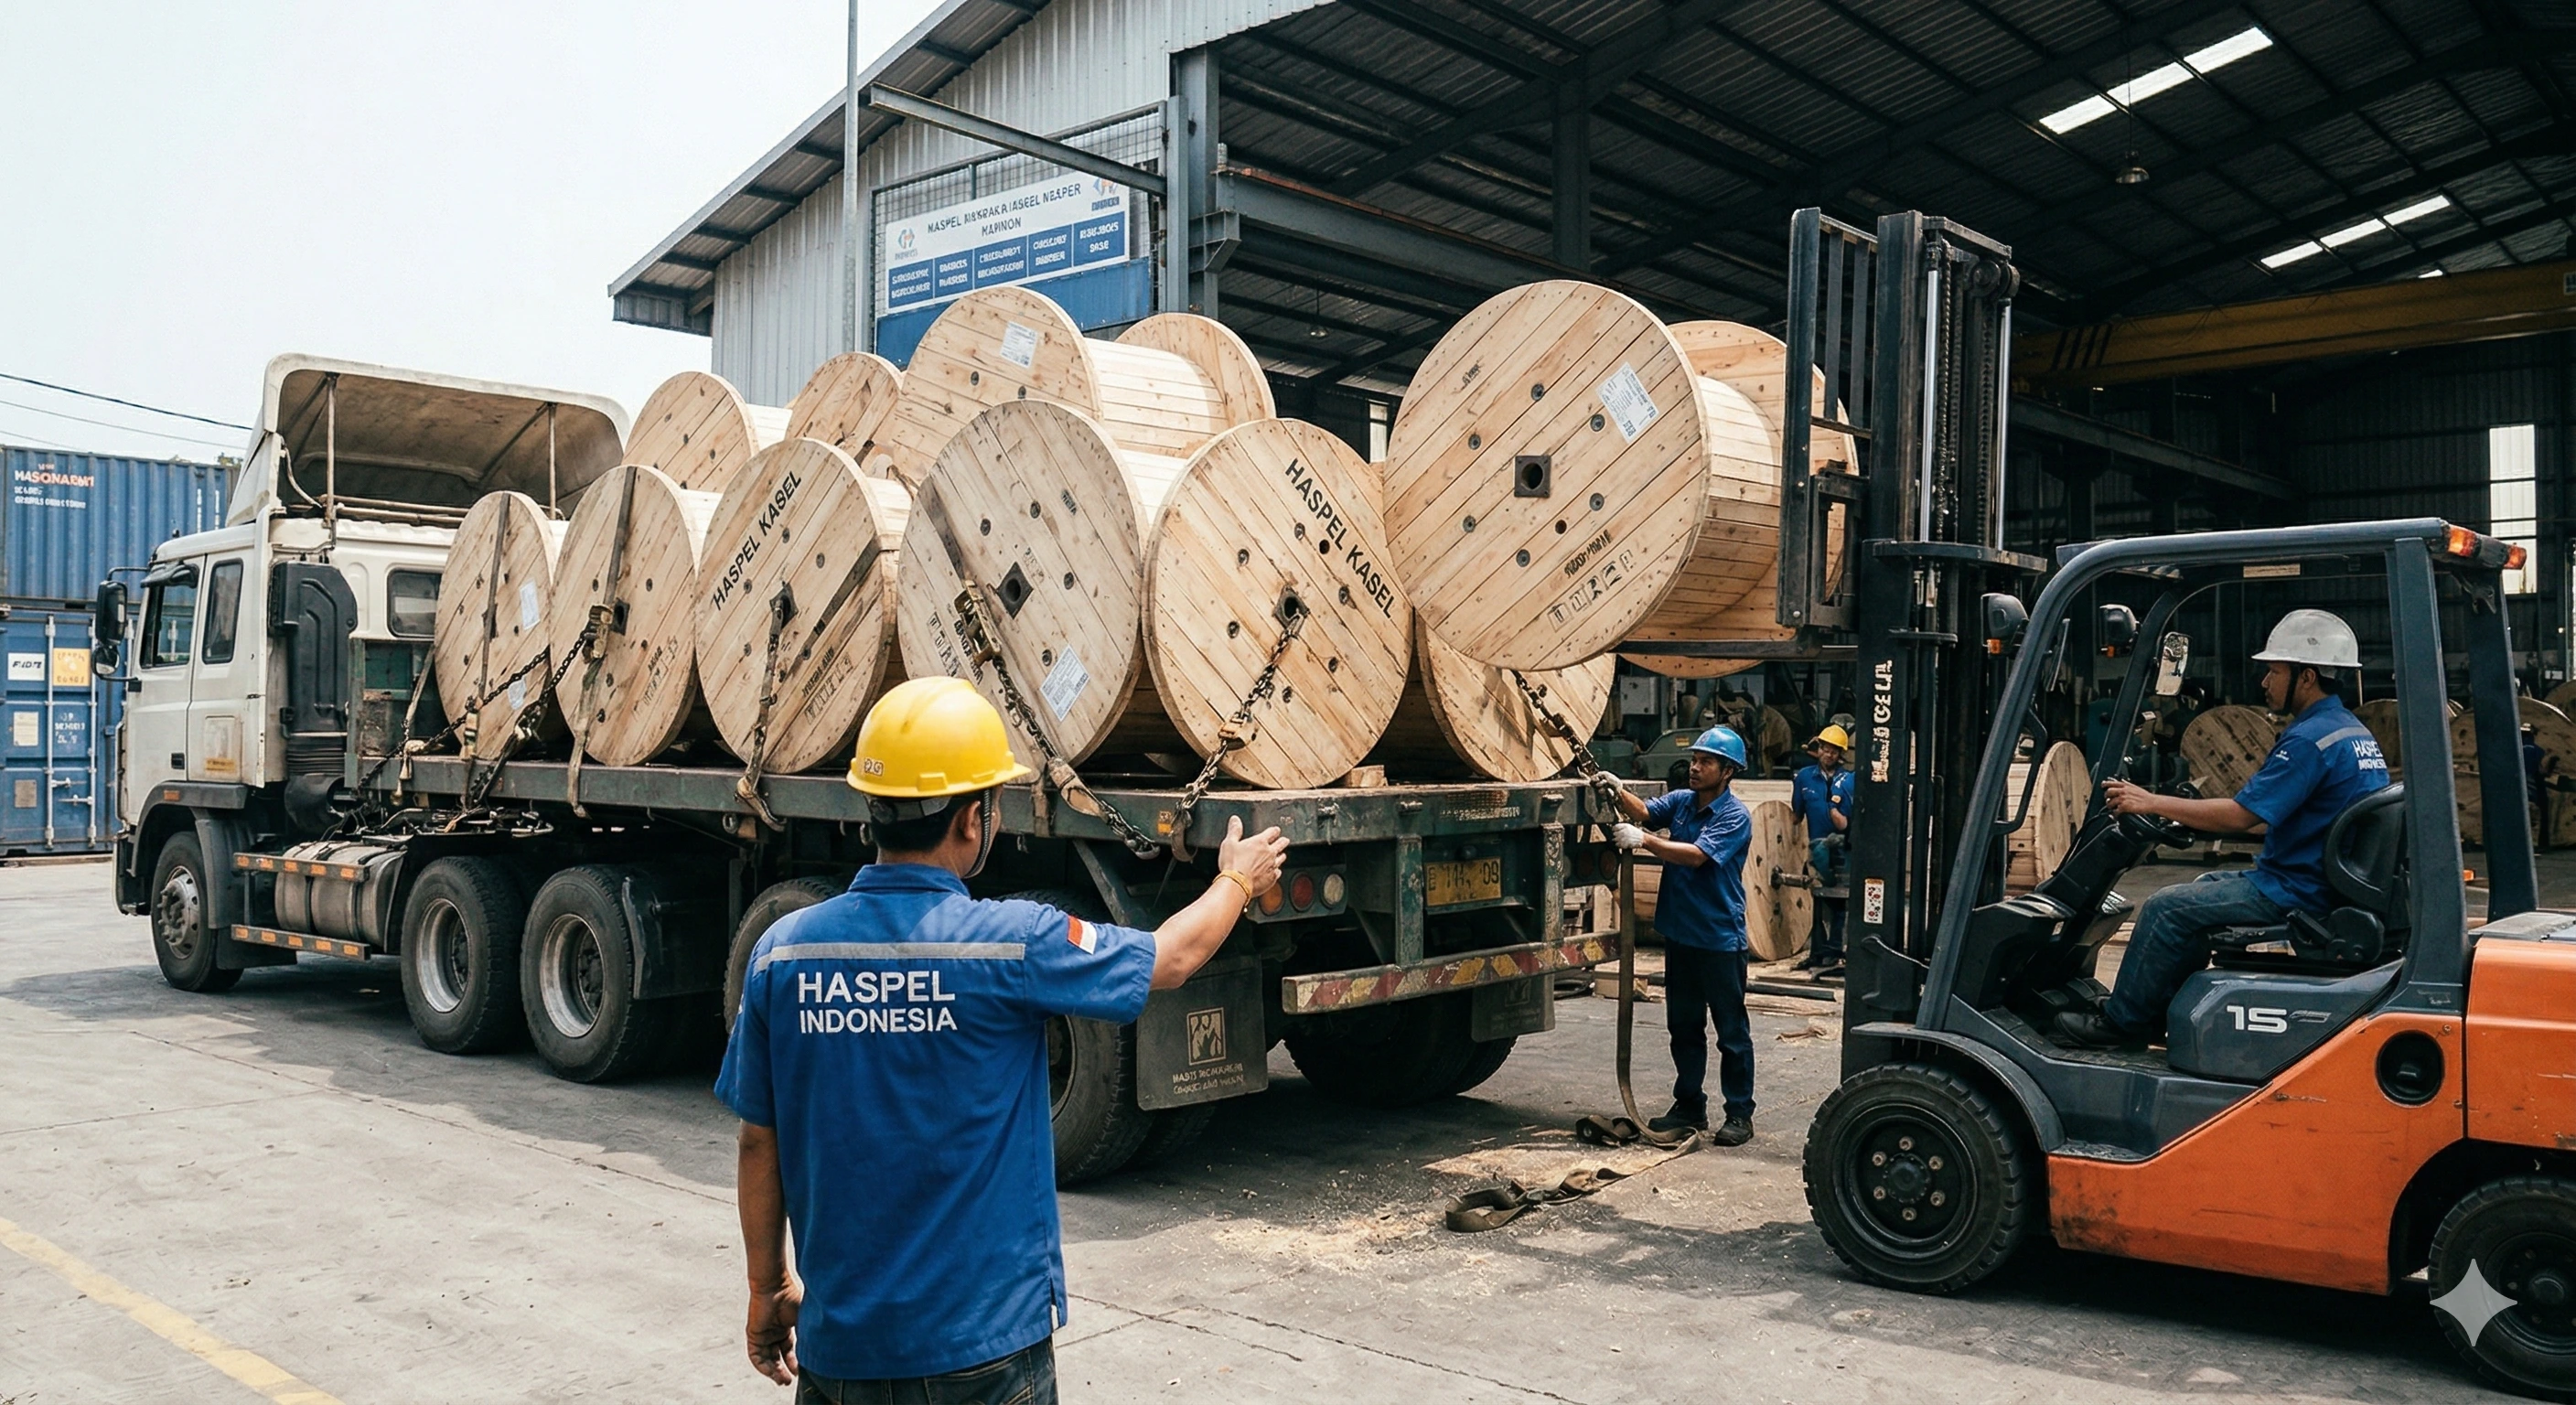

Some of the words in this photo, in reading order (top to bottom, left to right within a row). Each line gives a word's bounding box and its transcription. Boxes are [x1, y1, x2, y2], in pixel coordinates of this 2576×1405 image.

[1285, 457, 1347, 551] HASPEL
[1346, 544, 1395, 618] KASEL
[712, 535, 760, 611] HASPEL
[799, 971, 955, 1003] HASPEL
[800, 1007, 958, 1034] INDONESIA
[2227, 1005, 2287, 1034] 15
